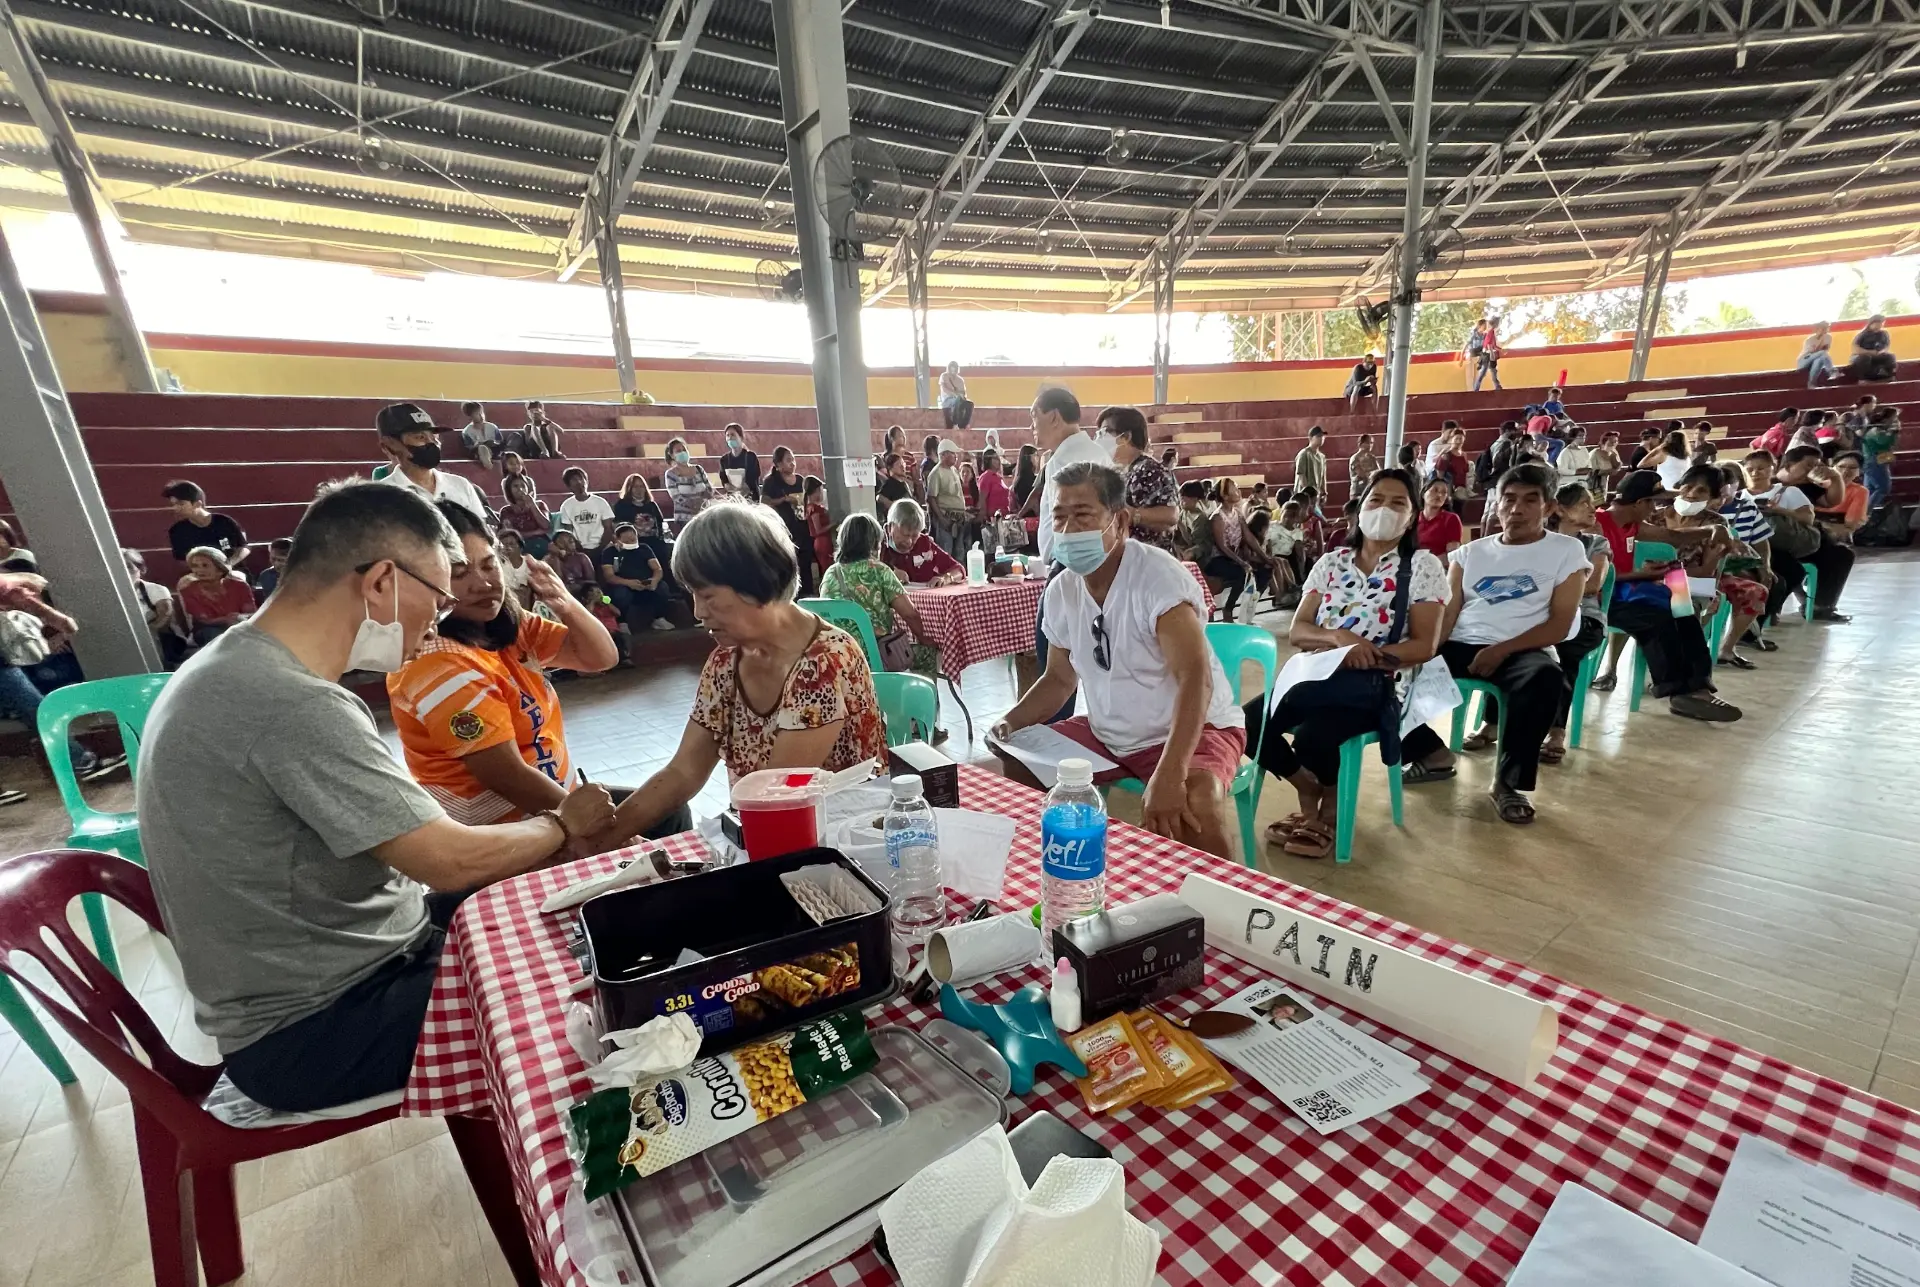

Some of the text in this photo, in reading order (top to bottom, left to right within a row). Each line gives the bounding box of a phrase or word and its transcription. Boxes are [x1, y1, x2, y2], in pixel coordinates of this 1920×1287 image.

[1245, 908, 1378, 993] PAIN
[1117, 962, 1155, 985] SPRING
[664, 994, 695, 1012] 3.3L
[724, 982, 761, 1003] GOOD
[809, 1029, 833, 1062] Made
[832, 1043, 853, 1072] Real
